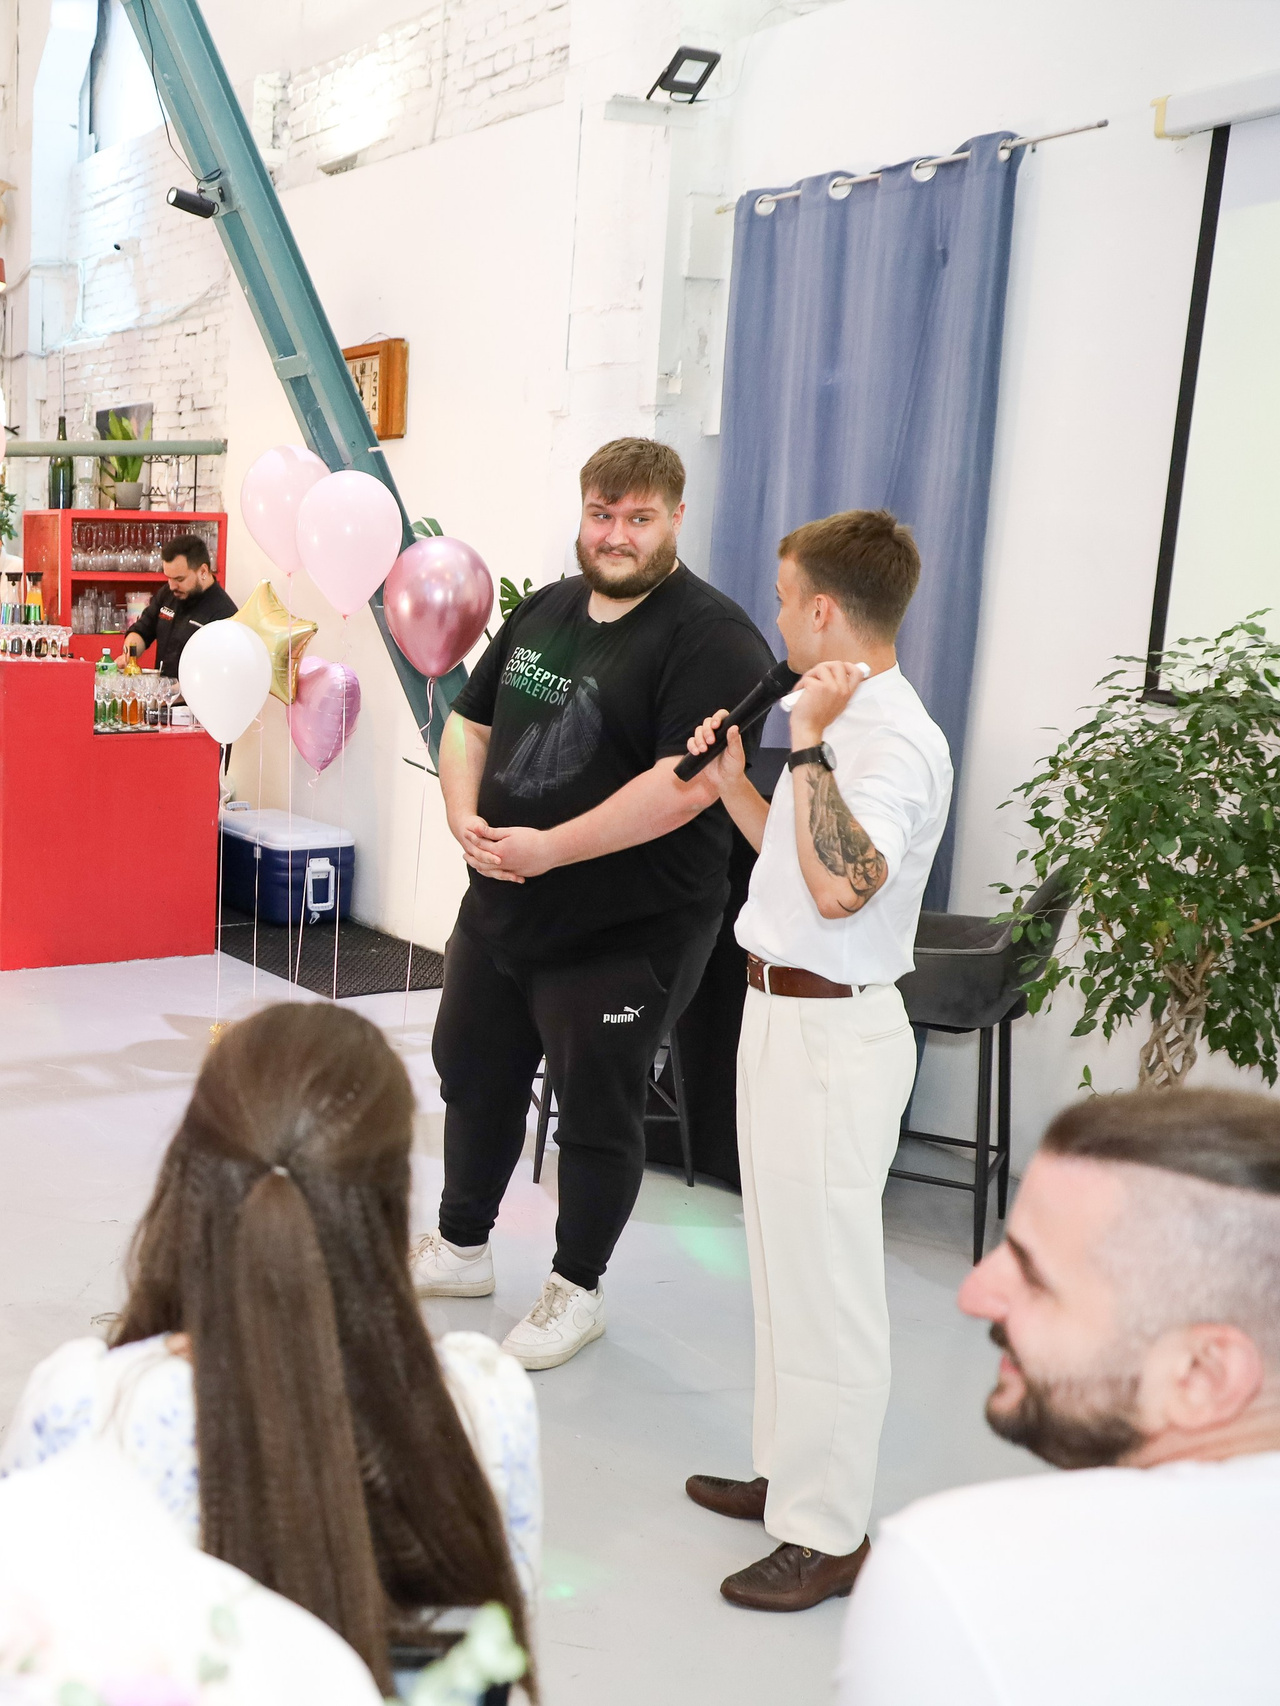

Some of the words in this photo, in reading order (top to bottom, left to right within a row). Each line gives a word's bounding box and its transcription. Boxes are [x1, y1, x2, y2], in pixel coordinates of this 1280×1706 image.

[373, 371, 378, 382] 2
[372, 386, 377, 397] 3
[371, 401, 377, 411] 4
[511, 646, 542, 664] FROM
[505, 658, 559, 688] CONCEPT
[500, 671, 568, 706] COMPLETION
[603, 1013, 634, 1023] PUMA
